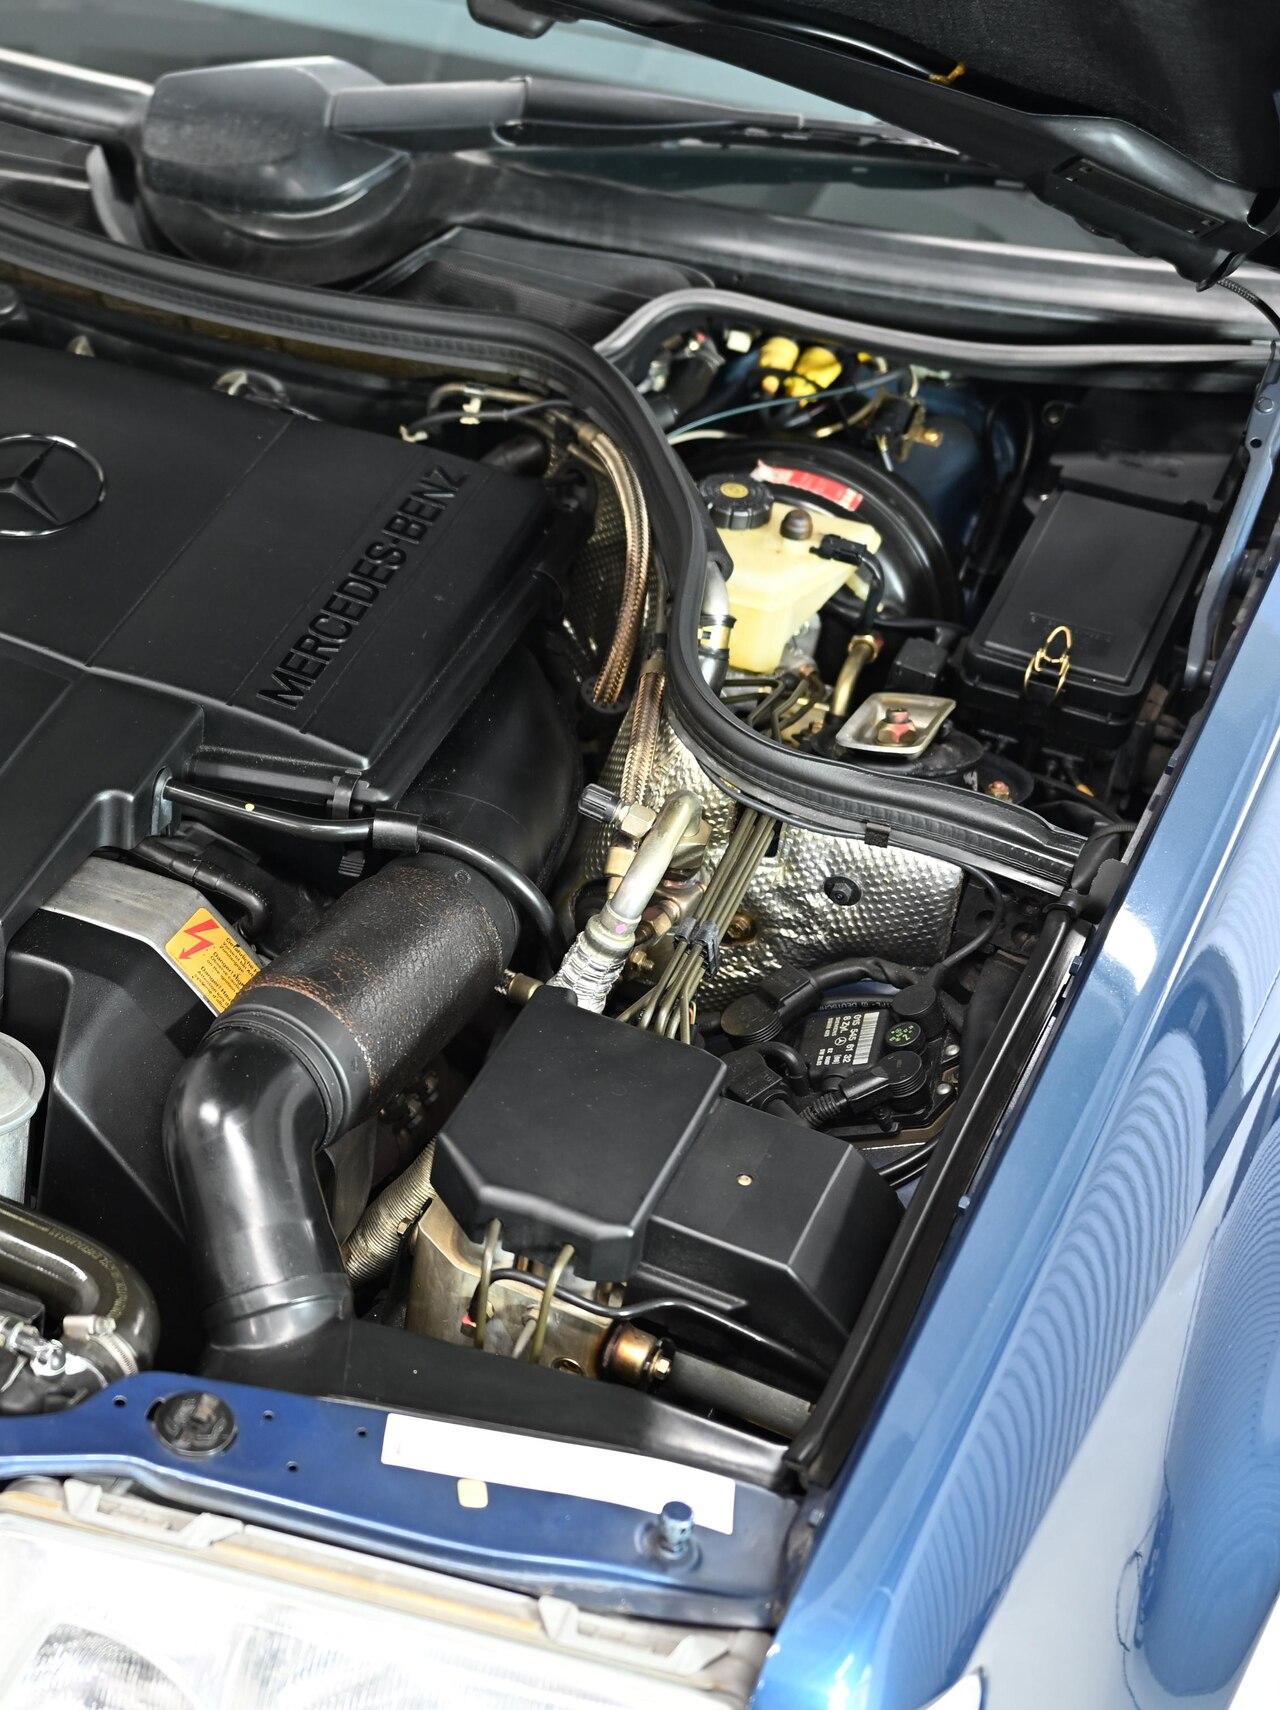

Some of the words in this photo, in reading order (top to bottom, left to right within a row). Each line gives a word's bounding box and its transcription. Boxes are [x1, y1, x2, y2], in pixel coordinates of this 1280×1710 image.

[256, 465, 468, 710] MERCEDES-BENZ
[213, 952, 233, 975] Danger!
[201, 966, 221, 989] Danger!
[852, 1014, 862, 1026] 015
[848, 1028, 858, 1041] 545
[845, 1043, 855, 1052] 61
[842, 1054, 852, 1063] 32
